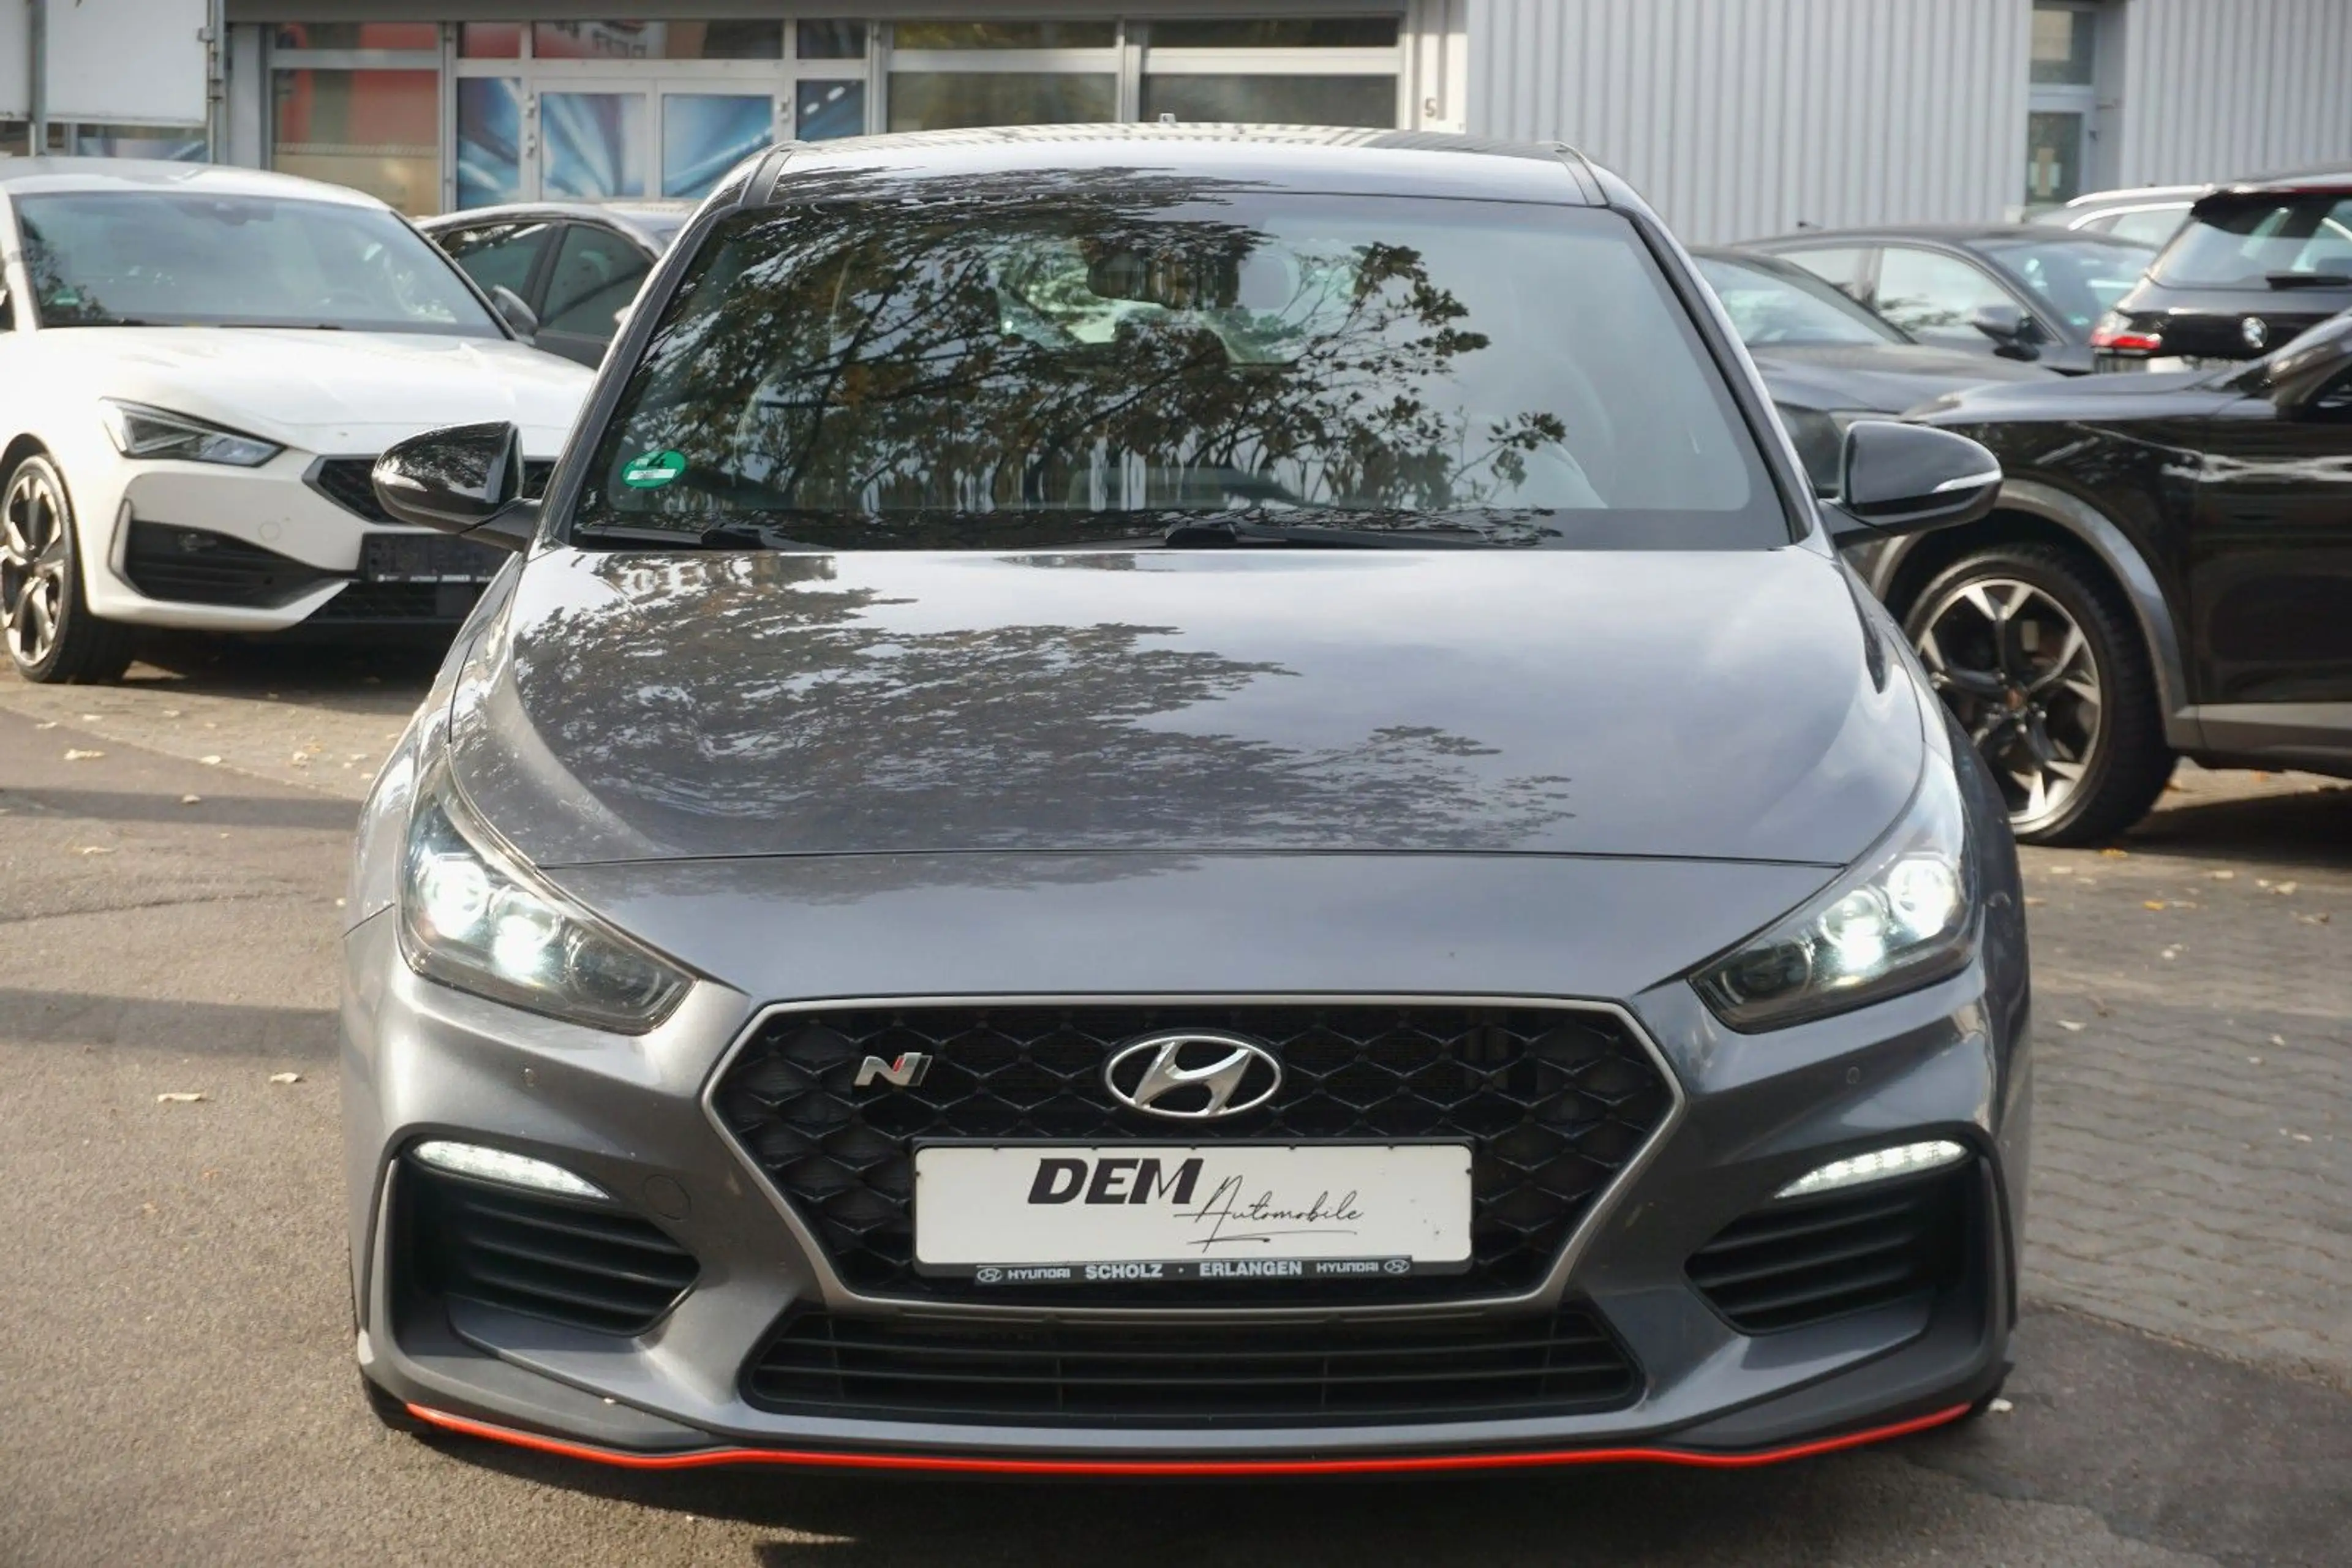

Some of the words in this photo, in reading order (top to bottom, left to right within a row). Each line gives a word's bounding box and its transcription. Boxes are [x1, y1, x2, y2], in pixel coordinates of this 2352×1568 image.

[1027, 1157, 1204, 1205] DEM
[1173, 1174, 1364, 1253] Automobile
[1008, 1268, 1071, 1280] HYUNDAI
[1085, 1264, 1163, 1280] SCHOLZ
[1199, 1261, 1302, 1276] ERLANGEN
[1316, 1261, 1379, 1272] HYUNDAI
